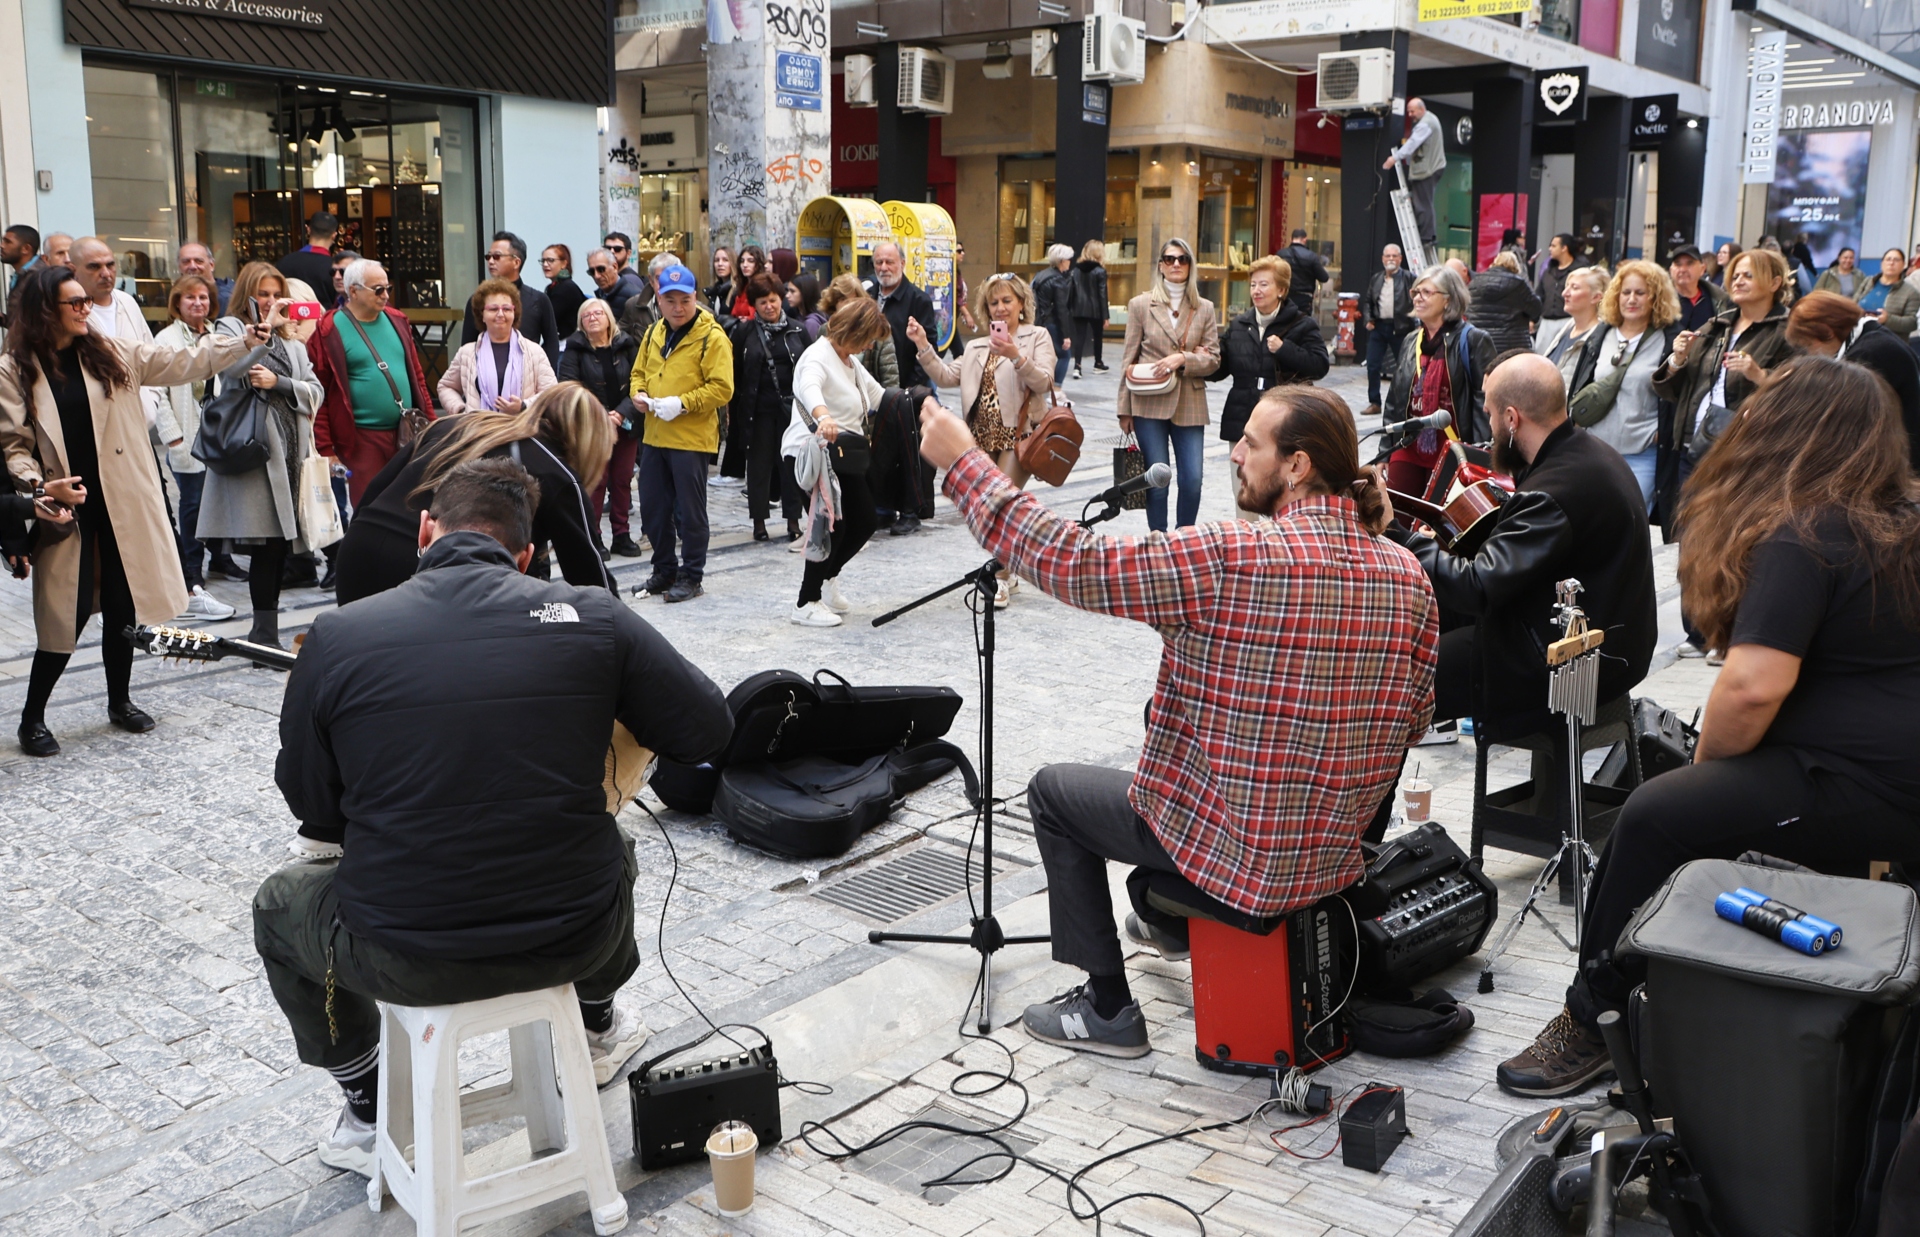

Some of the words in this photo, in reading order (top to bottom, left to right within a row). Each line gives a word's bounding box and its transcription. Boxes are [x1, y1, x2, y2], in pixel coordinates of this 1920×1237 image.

[224, 0, 323, 25] Accessories
[633, 14, 662, 27] DRESS
[664, 10, 689, 22] YOUR
[1423, 9, 1438, 19] 210
[1439, 5, 1471, 17] 3223555
[1477, 3, 1496, 13] 6932
[1498, 0, 1512, 10] 200
[1515, 0, 1529, 9] 100
[788, 56, 813, 67] ΟΔΟΣ
[785, 66, 815, 79] ΕΡΜΟΥ
[786, 77, 815, 89] ERMOU
[778, 97, 793, 106] ΑΠΟ
[1225, 92, 1289, 119] mamoglou
[1749, 40, 1780, 175] TERRANOVA
[1782, 99, 1895, 129] RRANOVA
[1793, 197, 1840, 206] ΜΠΟΥΦΑΝ
[530, 609, 562, 618] NORTH
[543, 602, 562, 610] THE
[540, 615, 563, 624] FACE
[1458, 906, 1485, 926] Roland
[1315, 910, 1331, 971] CUBE
[1318, 971, 1332, 1017] Street
[1060, 1013, 1090, 1040] N
